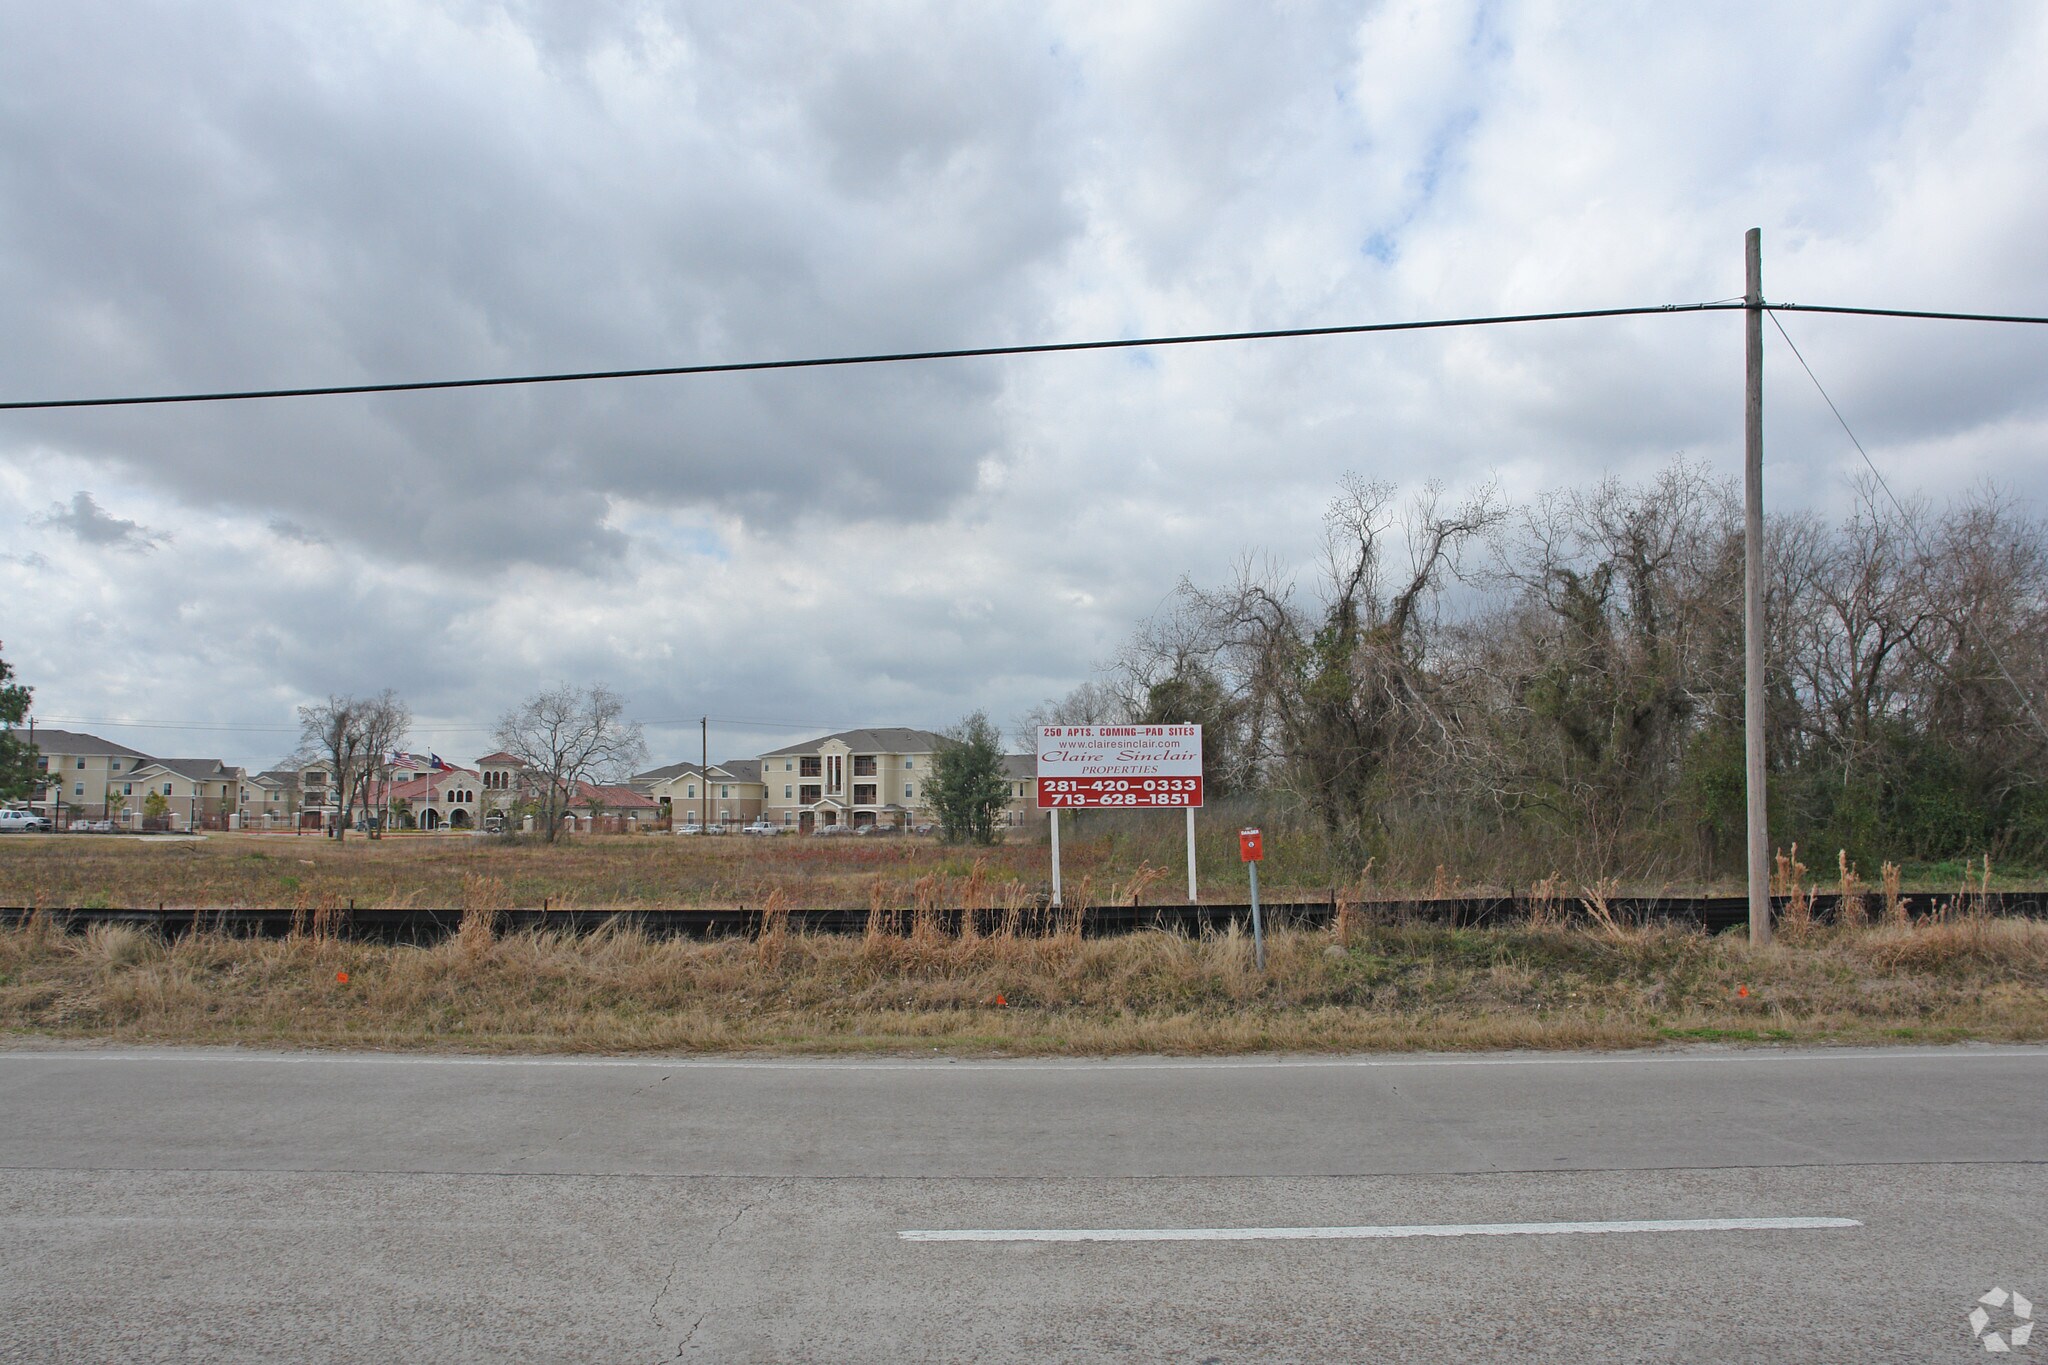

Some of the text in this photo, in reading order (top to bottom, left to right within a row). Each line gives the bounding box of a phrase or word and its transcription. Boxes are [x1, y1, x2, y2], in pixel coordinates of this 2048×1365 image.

[1044, 728, 1062, 736] 250
[1067, 728, 1094, 736] APTS.
[1169, 727, 1195, 736] SITES
[1059, 740, 1180, 748] www.clairesinclair.com
[1042, 750, 1197, 762] Claire Sinclair
[1082, 765, 1158, 774] PROPERTIES
[1044, 780, 1196, 791] 281-420-0333
[1052, 794, 1189, 805] 713-628-1851
